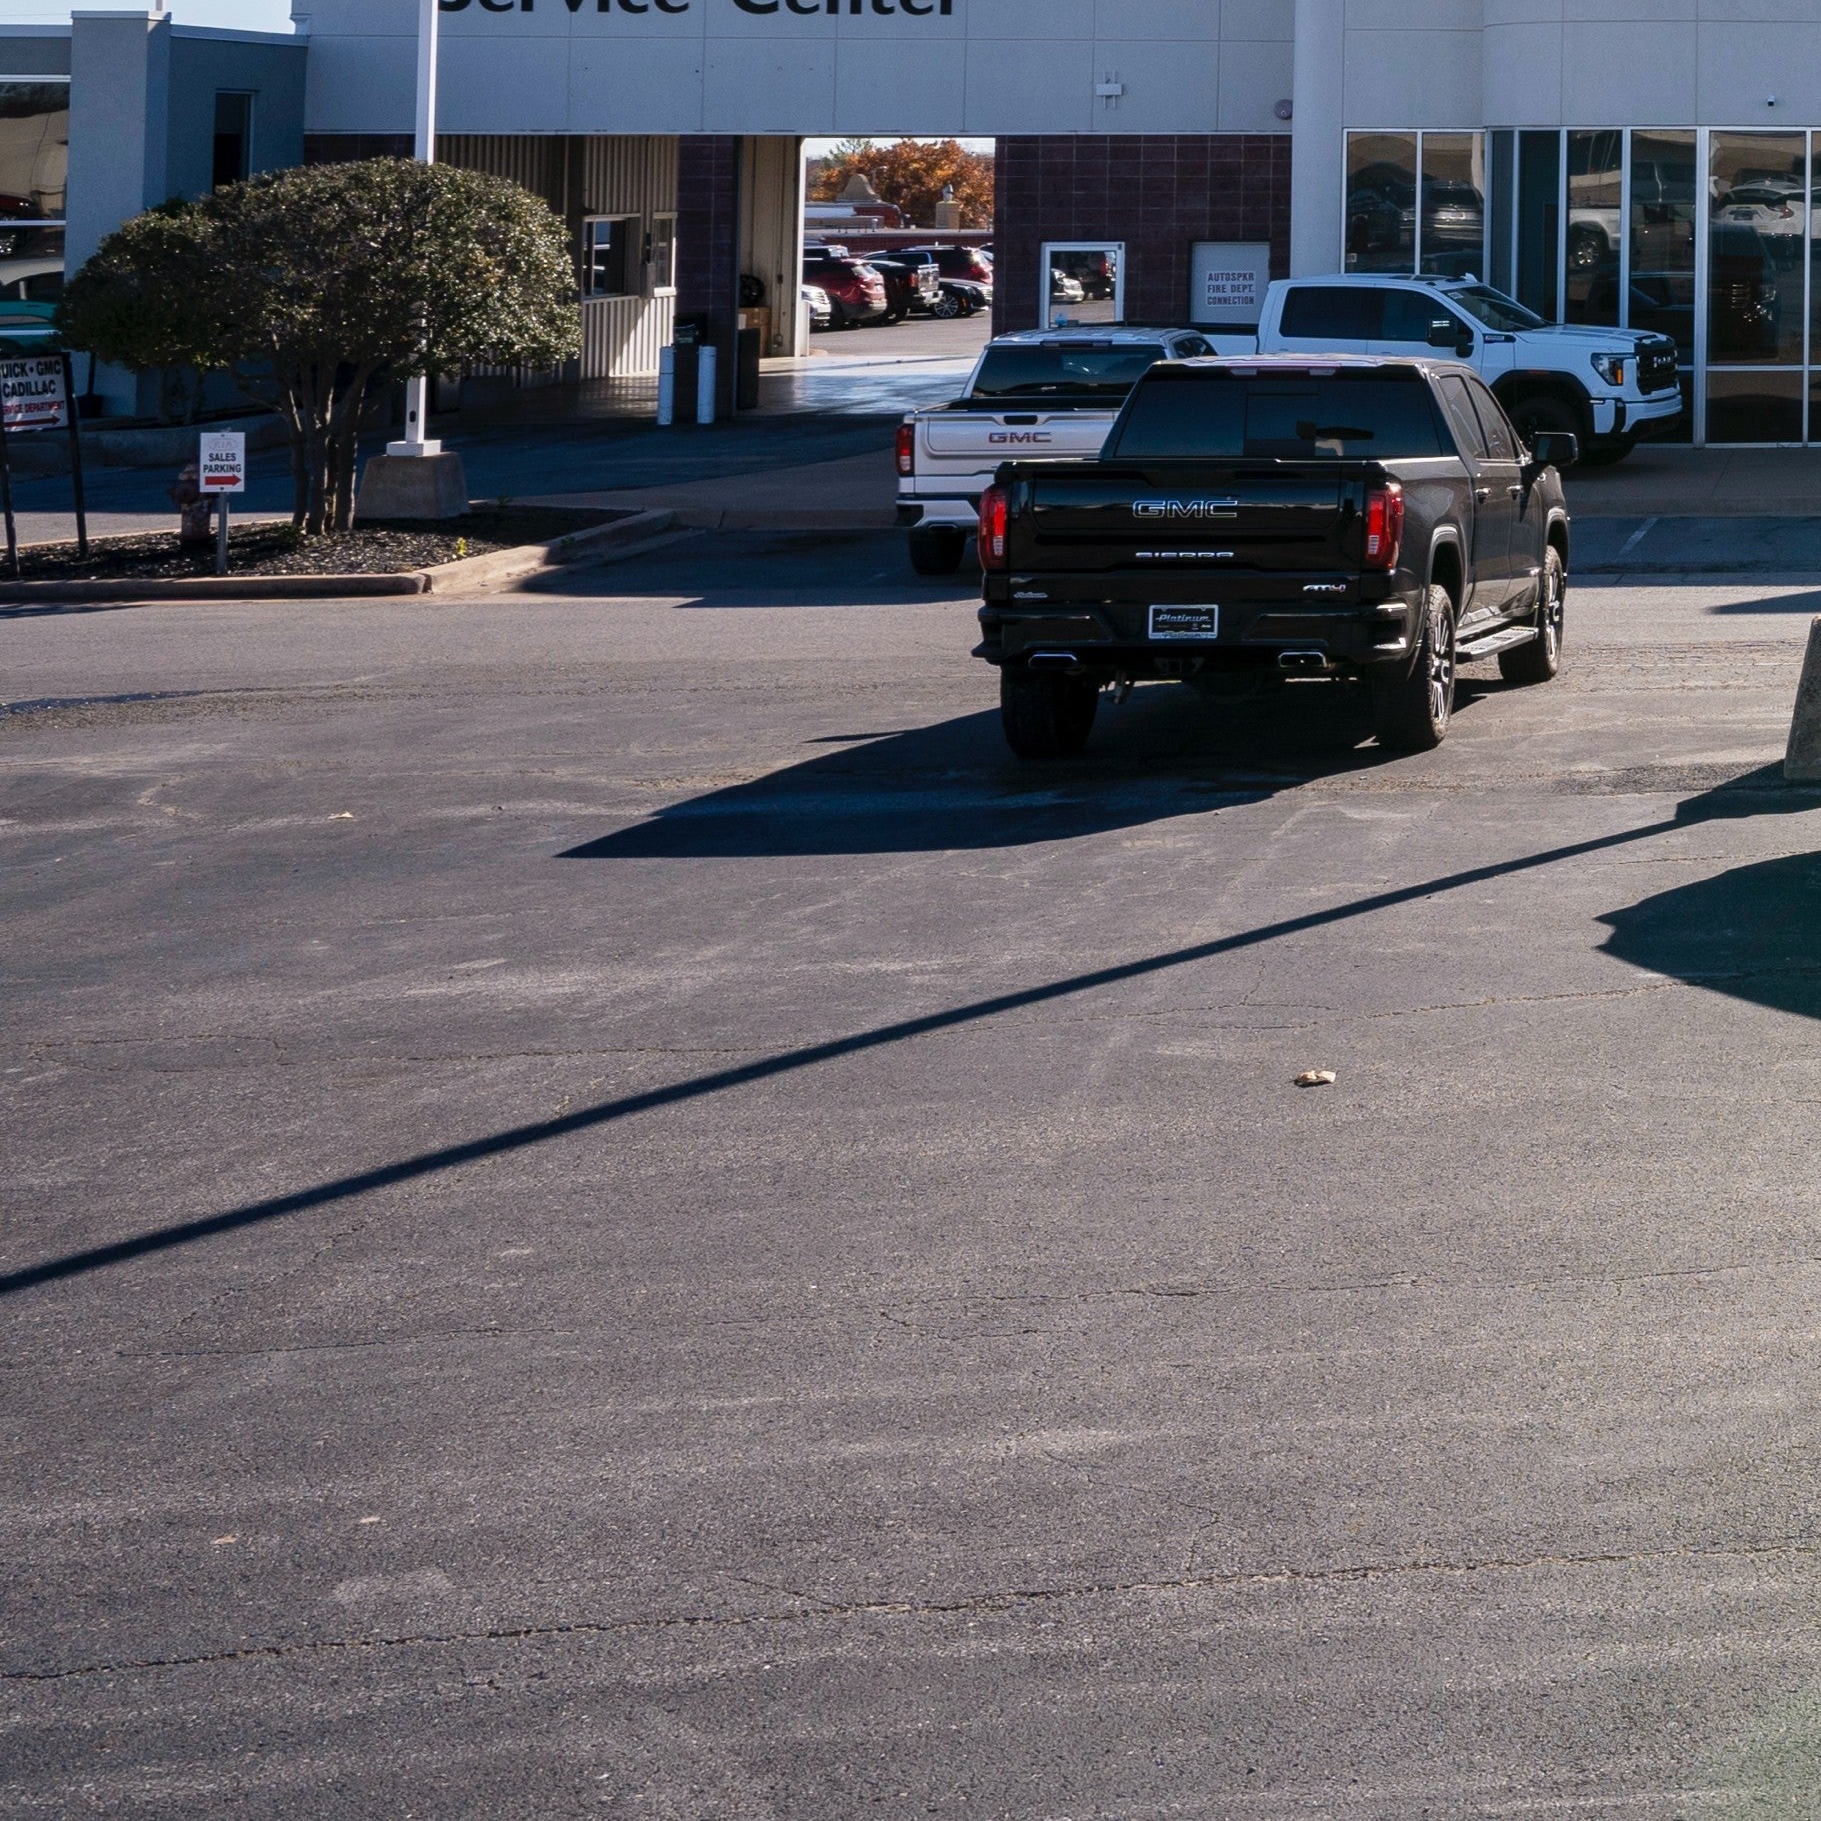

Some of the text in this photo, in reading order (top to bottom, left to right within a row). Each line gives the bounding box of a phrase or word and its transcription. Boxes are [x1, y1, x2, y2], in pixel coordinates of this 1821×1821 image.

[1207, 272, 1255, 282] AUTOSPKR
[1207, 284, 1255, 294] FIRE DEPT.
[1207, 296, 1255, 306] CONNECTION
[0, 360, 62, 379] UICK GMC
[3, 379, 57, 398] CADILLAC
[2, 404, 23, 415] ERVICE
[988, 432, 1052, 443] GMC
[208, 452, 237, 462] SALES
[202, 464, 242, 474] PARKING
[1132, 500, 1238, 518] GMC
